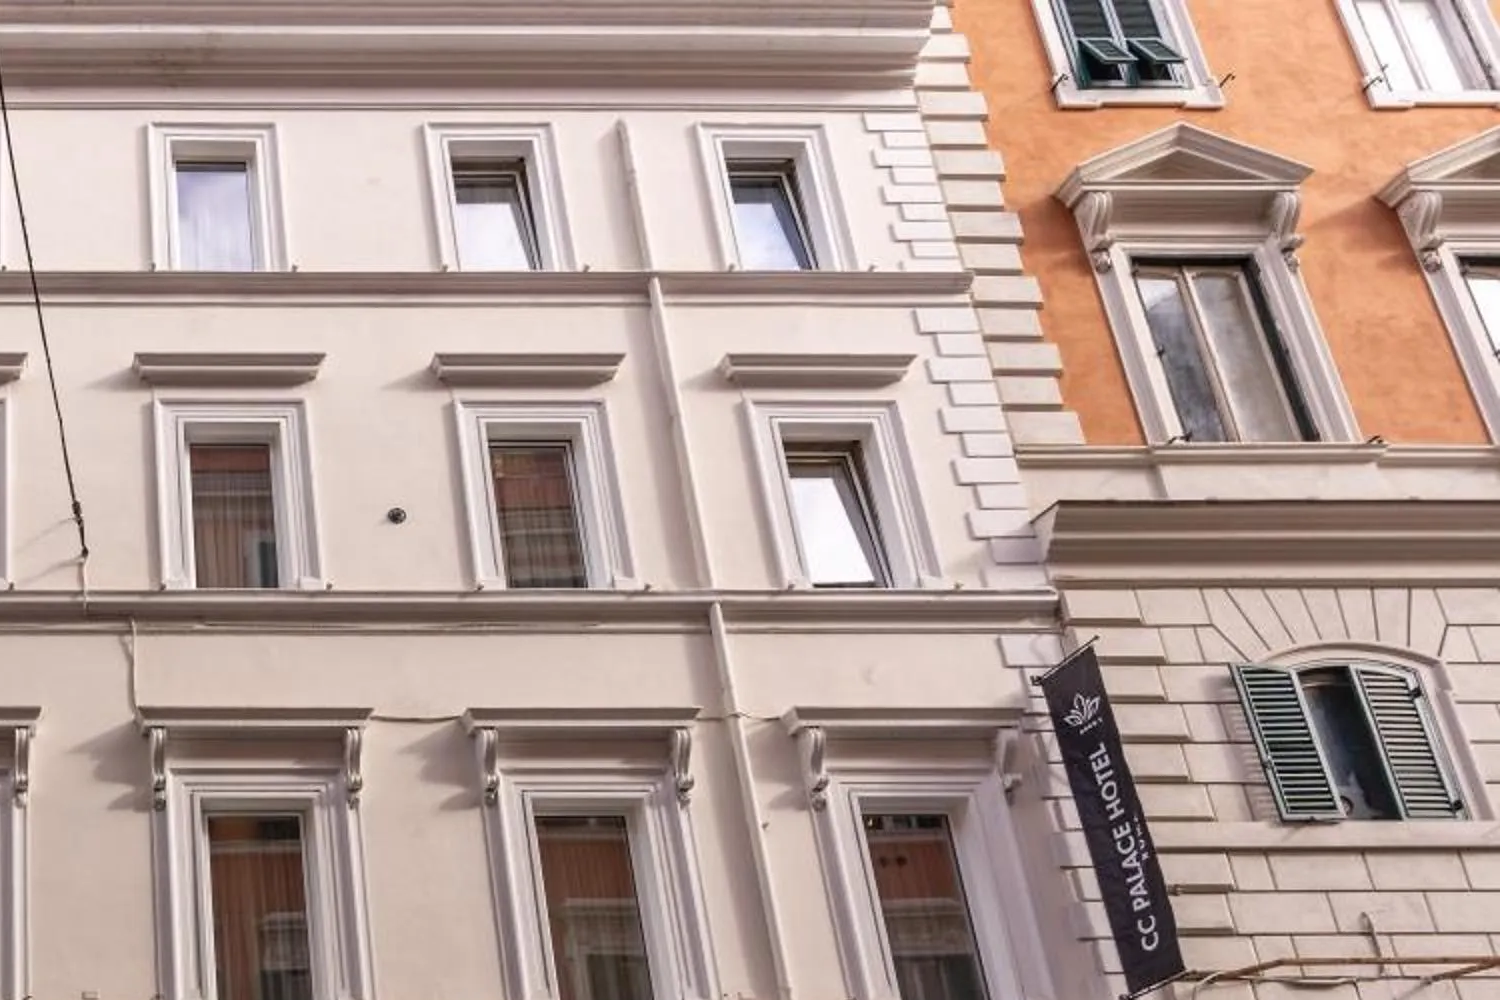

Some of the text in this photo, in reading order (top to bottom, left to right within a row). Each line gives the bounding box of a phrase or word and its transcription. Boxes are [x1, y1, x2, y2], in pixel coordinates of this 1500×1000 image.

[1088, 742, 1159, 951] CC PALACE HOTEL
